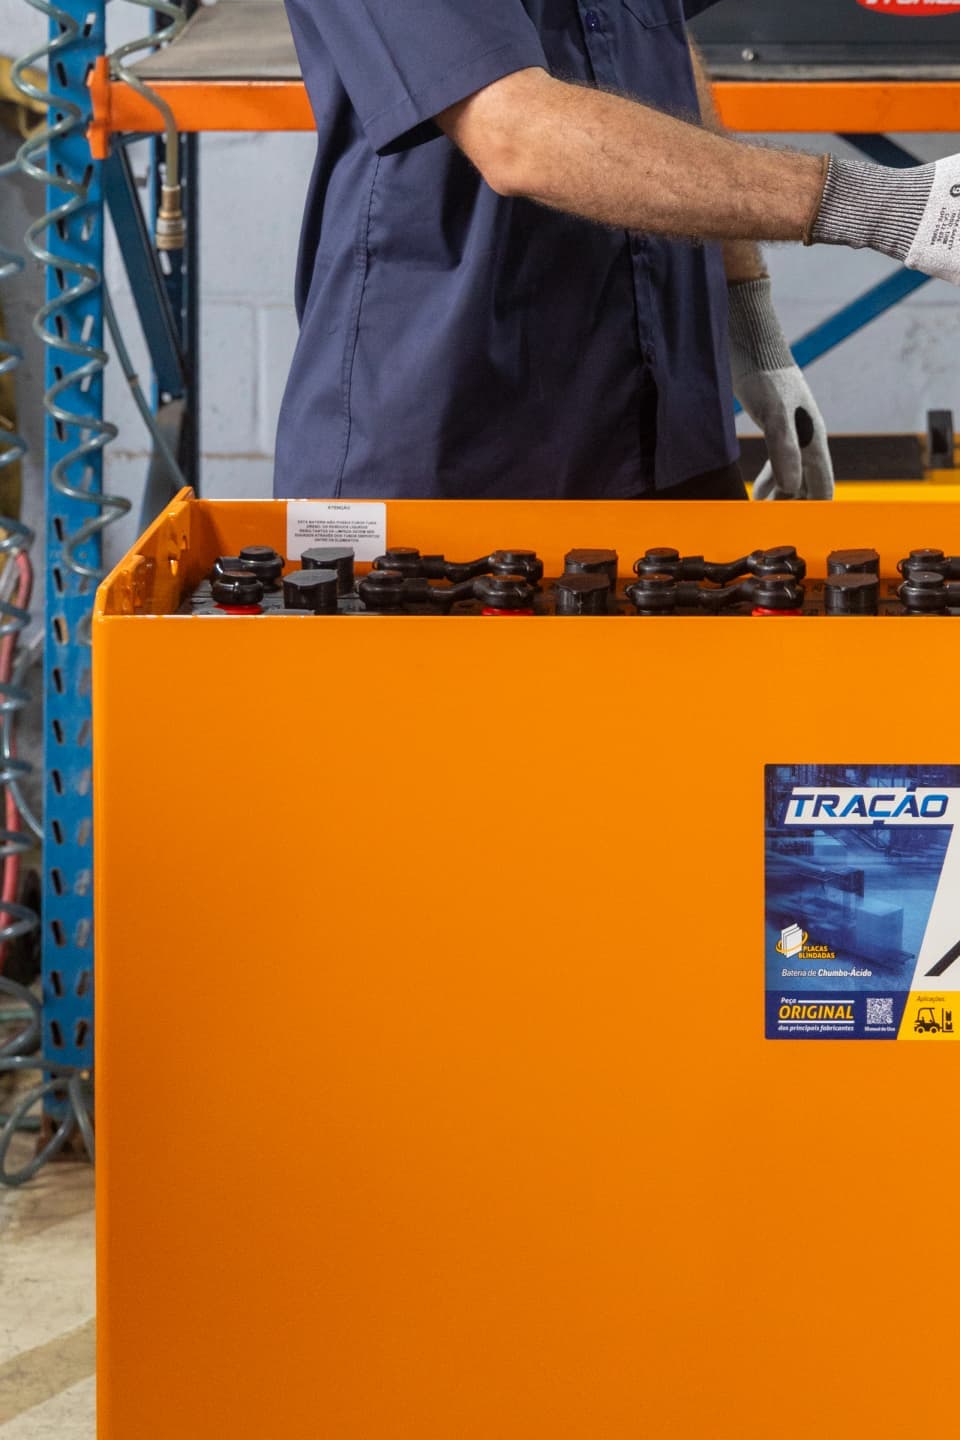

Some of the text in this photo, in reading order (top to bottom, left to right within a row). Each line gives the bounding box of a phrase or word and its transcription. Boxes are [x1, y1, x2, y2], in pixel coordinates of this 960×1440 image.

[782, 968, 807, 977] Bateria
[808, 968, 817, 977] de
[778, 1005, 854, 1020] ORIGINAL
